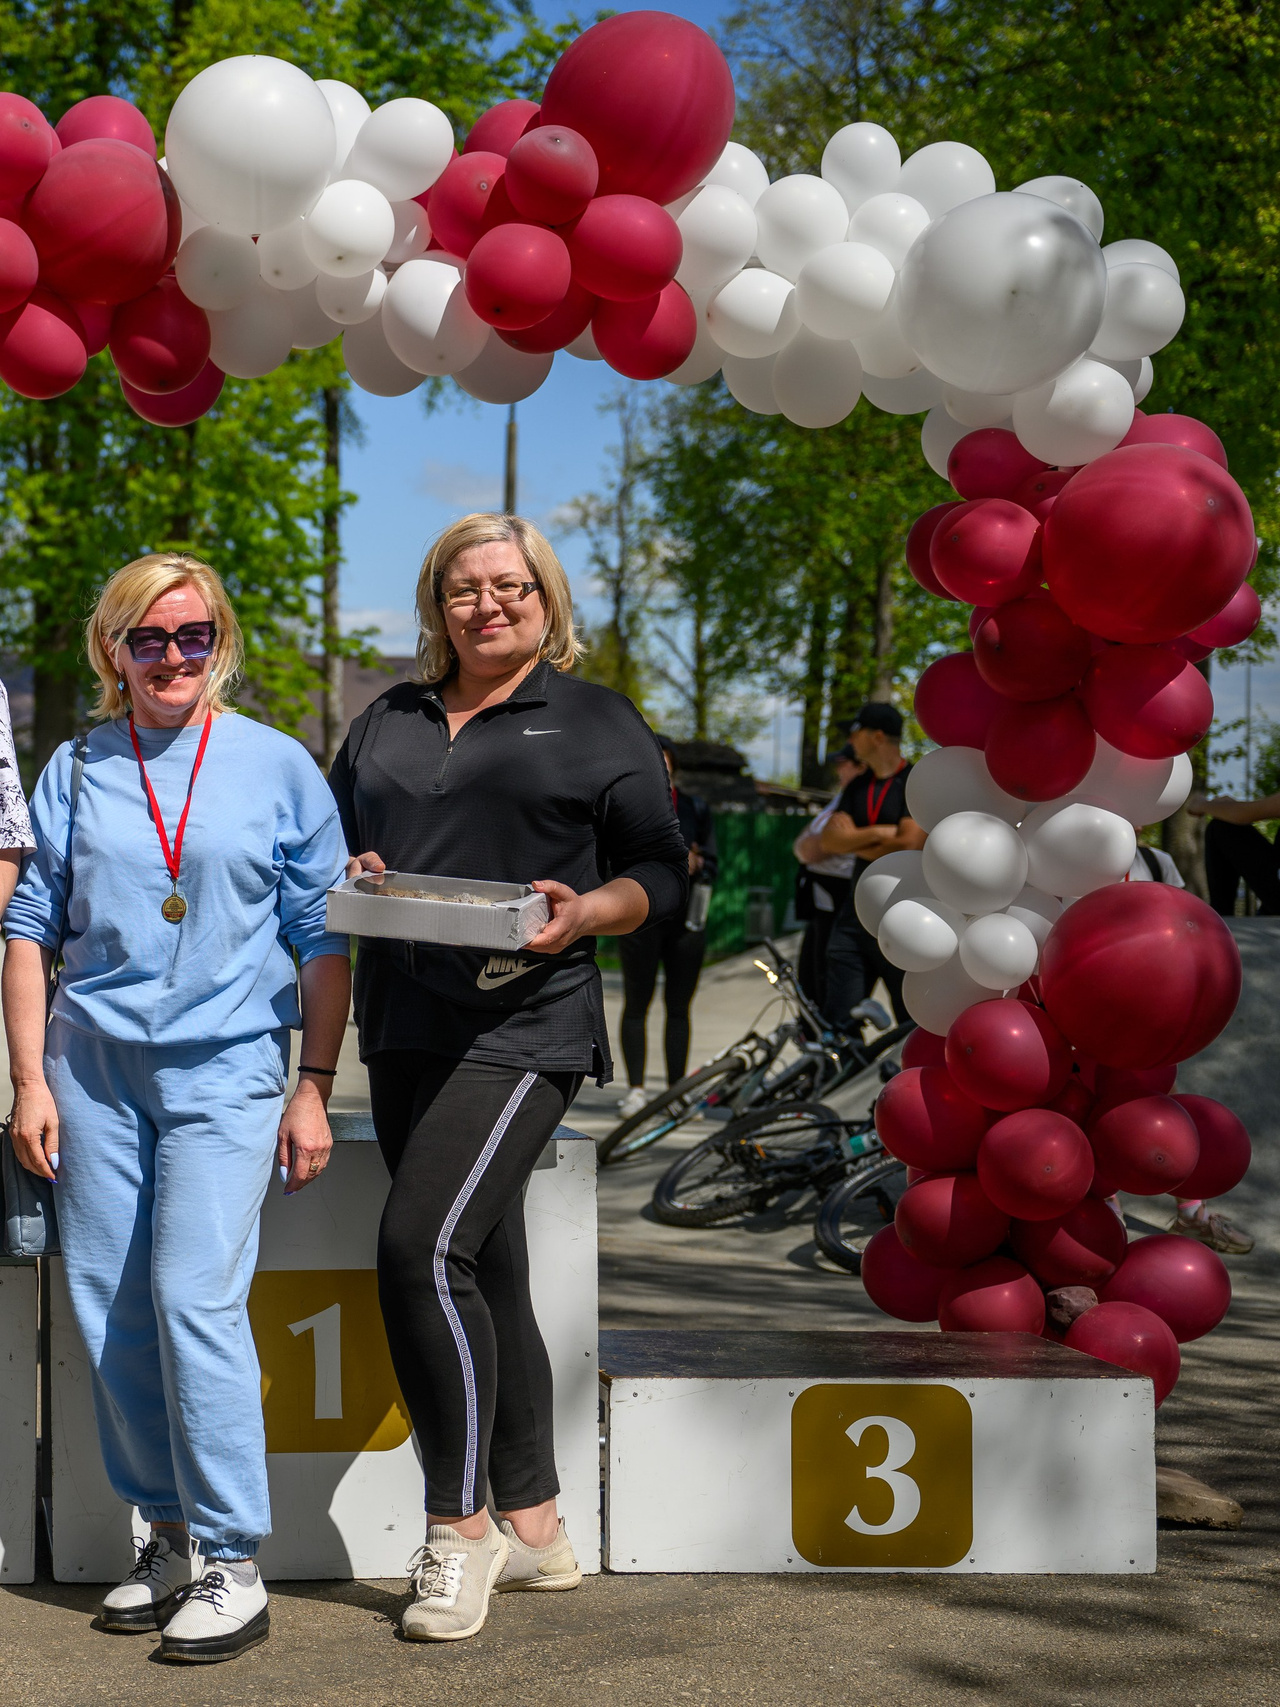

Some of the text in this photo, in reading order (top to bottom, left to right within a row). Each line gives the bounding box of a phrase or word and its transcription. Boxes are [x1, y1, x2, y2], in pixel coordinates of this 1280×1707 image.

[486, 955, 527, 973] NIKE
[286, 1302, 343, 1419] 1
[844, 1415, 921, 1536] 3
